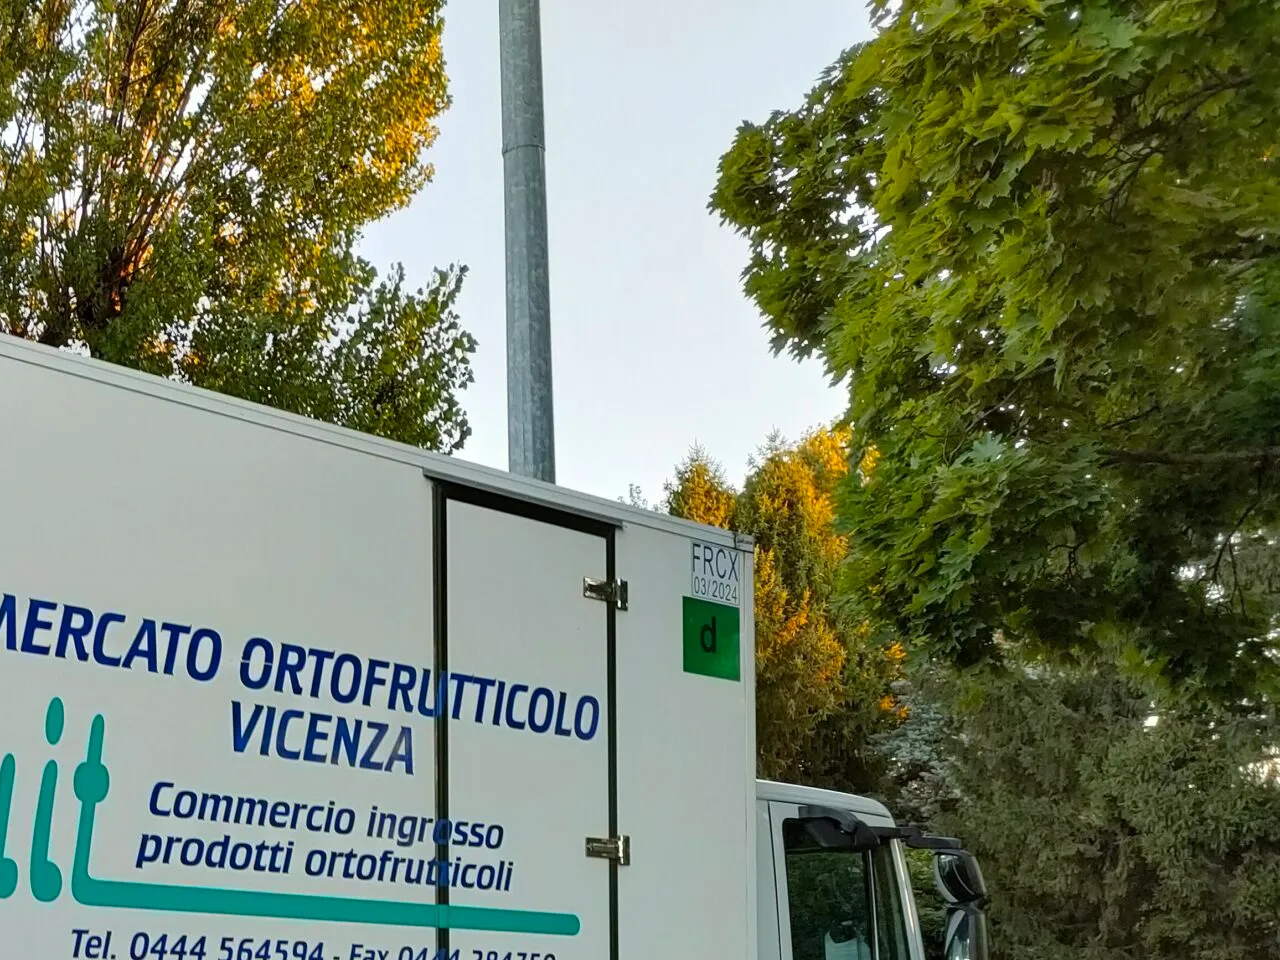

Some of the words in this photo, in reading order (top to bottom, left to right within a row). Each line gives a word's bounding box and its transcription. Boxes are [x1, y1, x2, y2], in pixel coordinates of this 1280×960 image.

[692, 543, 739, 582] FRCX
[693, 576, 738, 603] 03/2024
[700, 616, 717, 653] d
[238, 635, 601, 742] ORTOFRUTTICOLO
[230, 699, 415, 775] VICENZA
[148, 780, 356, 836] Commercio
[366, 804, 505, 850] ingrosso
[135, 832, 294, 874] prodotti
[304, 847, 514, 892] ortofrutticoli
[70, 929, 117, 960] Tel.
